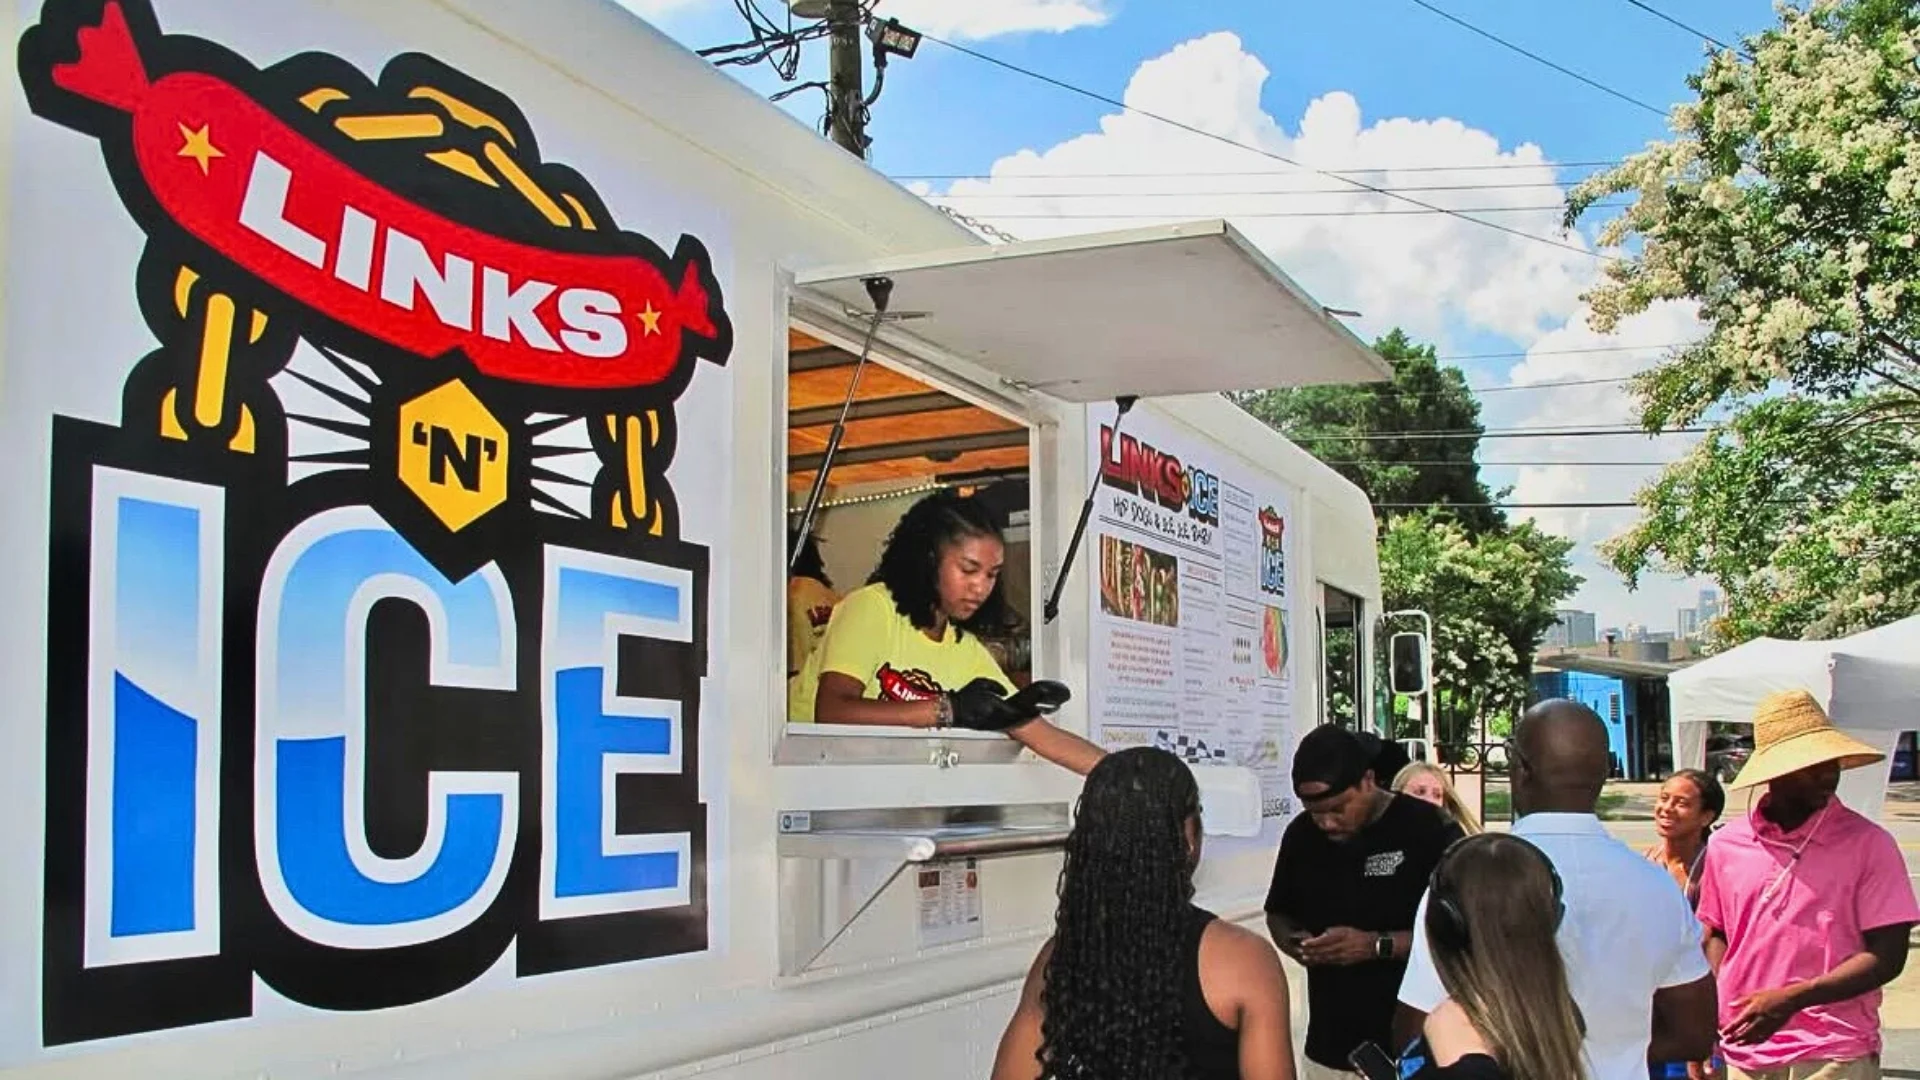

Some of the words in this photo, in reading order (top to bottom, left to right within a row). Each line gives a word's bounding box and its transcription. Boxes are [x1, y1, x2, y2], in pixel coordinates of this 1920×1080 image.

[239, 150, 628, 359] LINKS
[1100, 424, 1182, 512] LINKS
[1188, 465, 1218, 526] ICE
[84, 463, 693, 968] ICE
[892, 681, 929, 701] LIN
